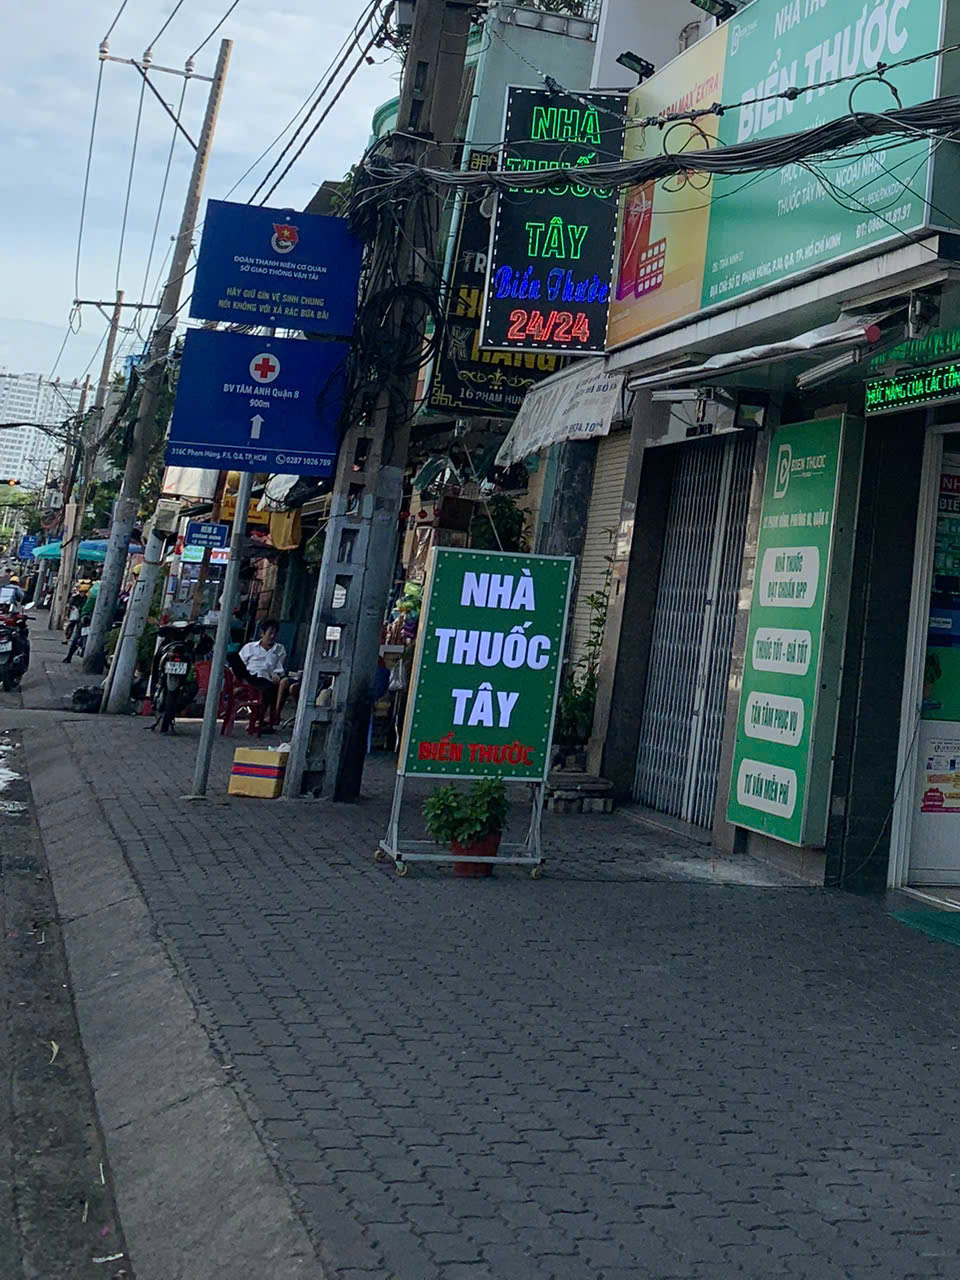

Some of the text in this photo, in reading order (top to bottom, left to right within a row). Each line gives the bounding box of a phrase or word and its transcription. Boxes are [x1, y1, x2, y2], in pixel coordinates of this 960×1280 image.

[531, 106, 602, 145] NHÀ
[526, 217, 588, 260] TÂY
[508, 308, 590, 342] 24/24
[224, 384, 300, 400] BV TÂM ANH Quận 8
[249, 398, 270, 408] 900m
[460, 387, 474, 400] 16
[286, 456, 302, 464] 0287
[460, 568, 536, 611] NHÀ
[434, 622, 551, 670] THUỐC
[452, 682, 520, 728] TÂY
